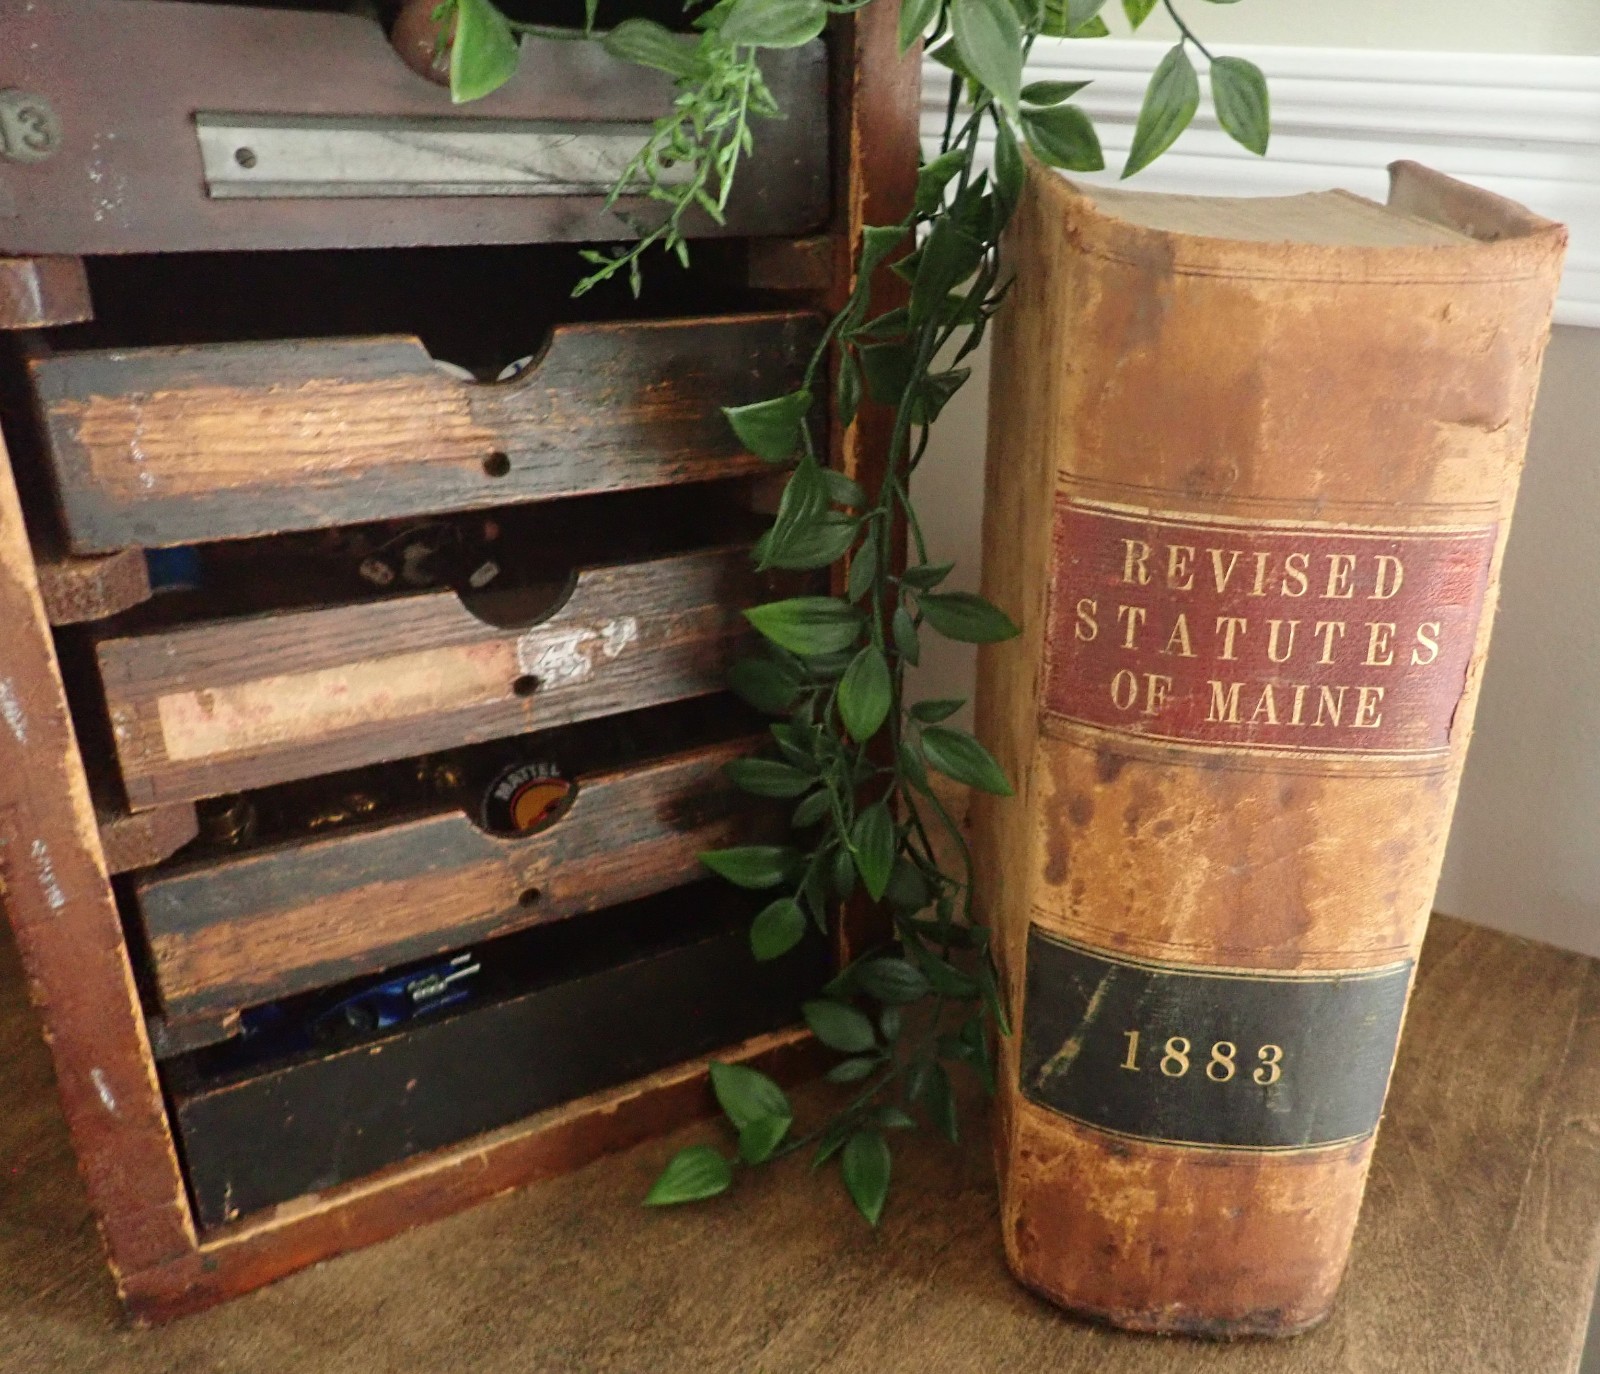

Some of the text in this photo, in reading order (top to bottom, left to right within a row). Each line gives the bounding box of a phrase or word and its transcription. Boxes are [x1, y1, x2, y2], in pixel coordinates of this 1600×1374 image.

[1120, 538, 1404, 600] REVISED
[1074, 598, 1442, 666] STATUTES
[1110, 669, 1386, 729] OF MAINE
[494, 762, 561, 801] MATTEL
[1120, 1030, 1284, 1086] 1883
